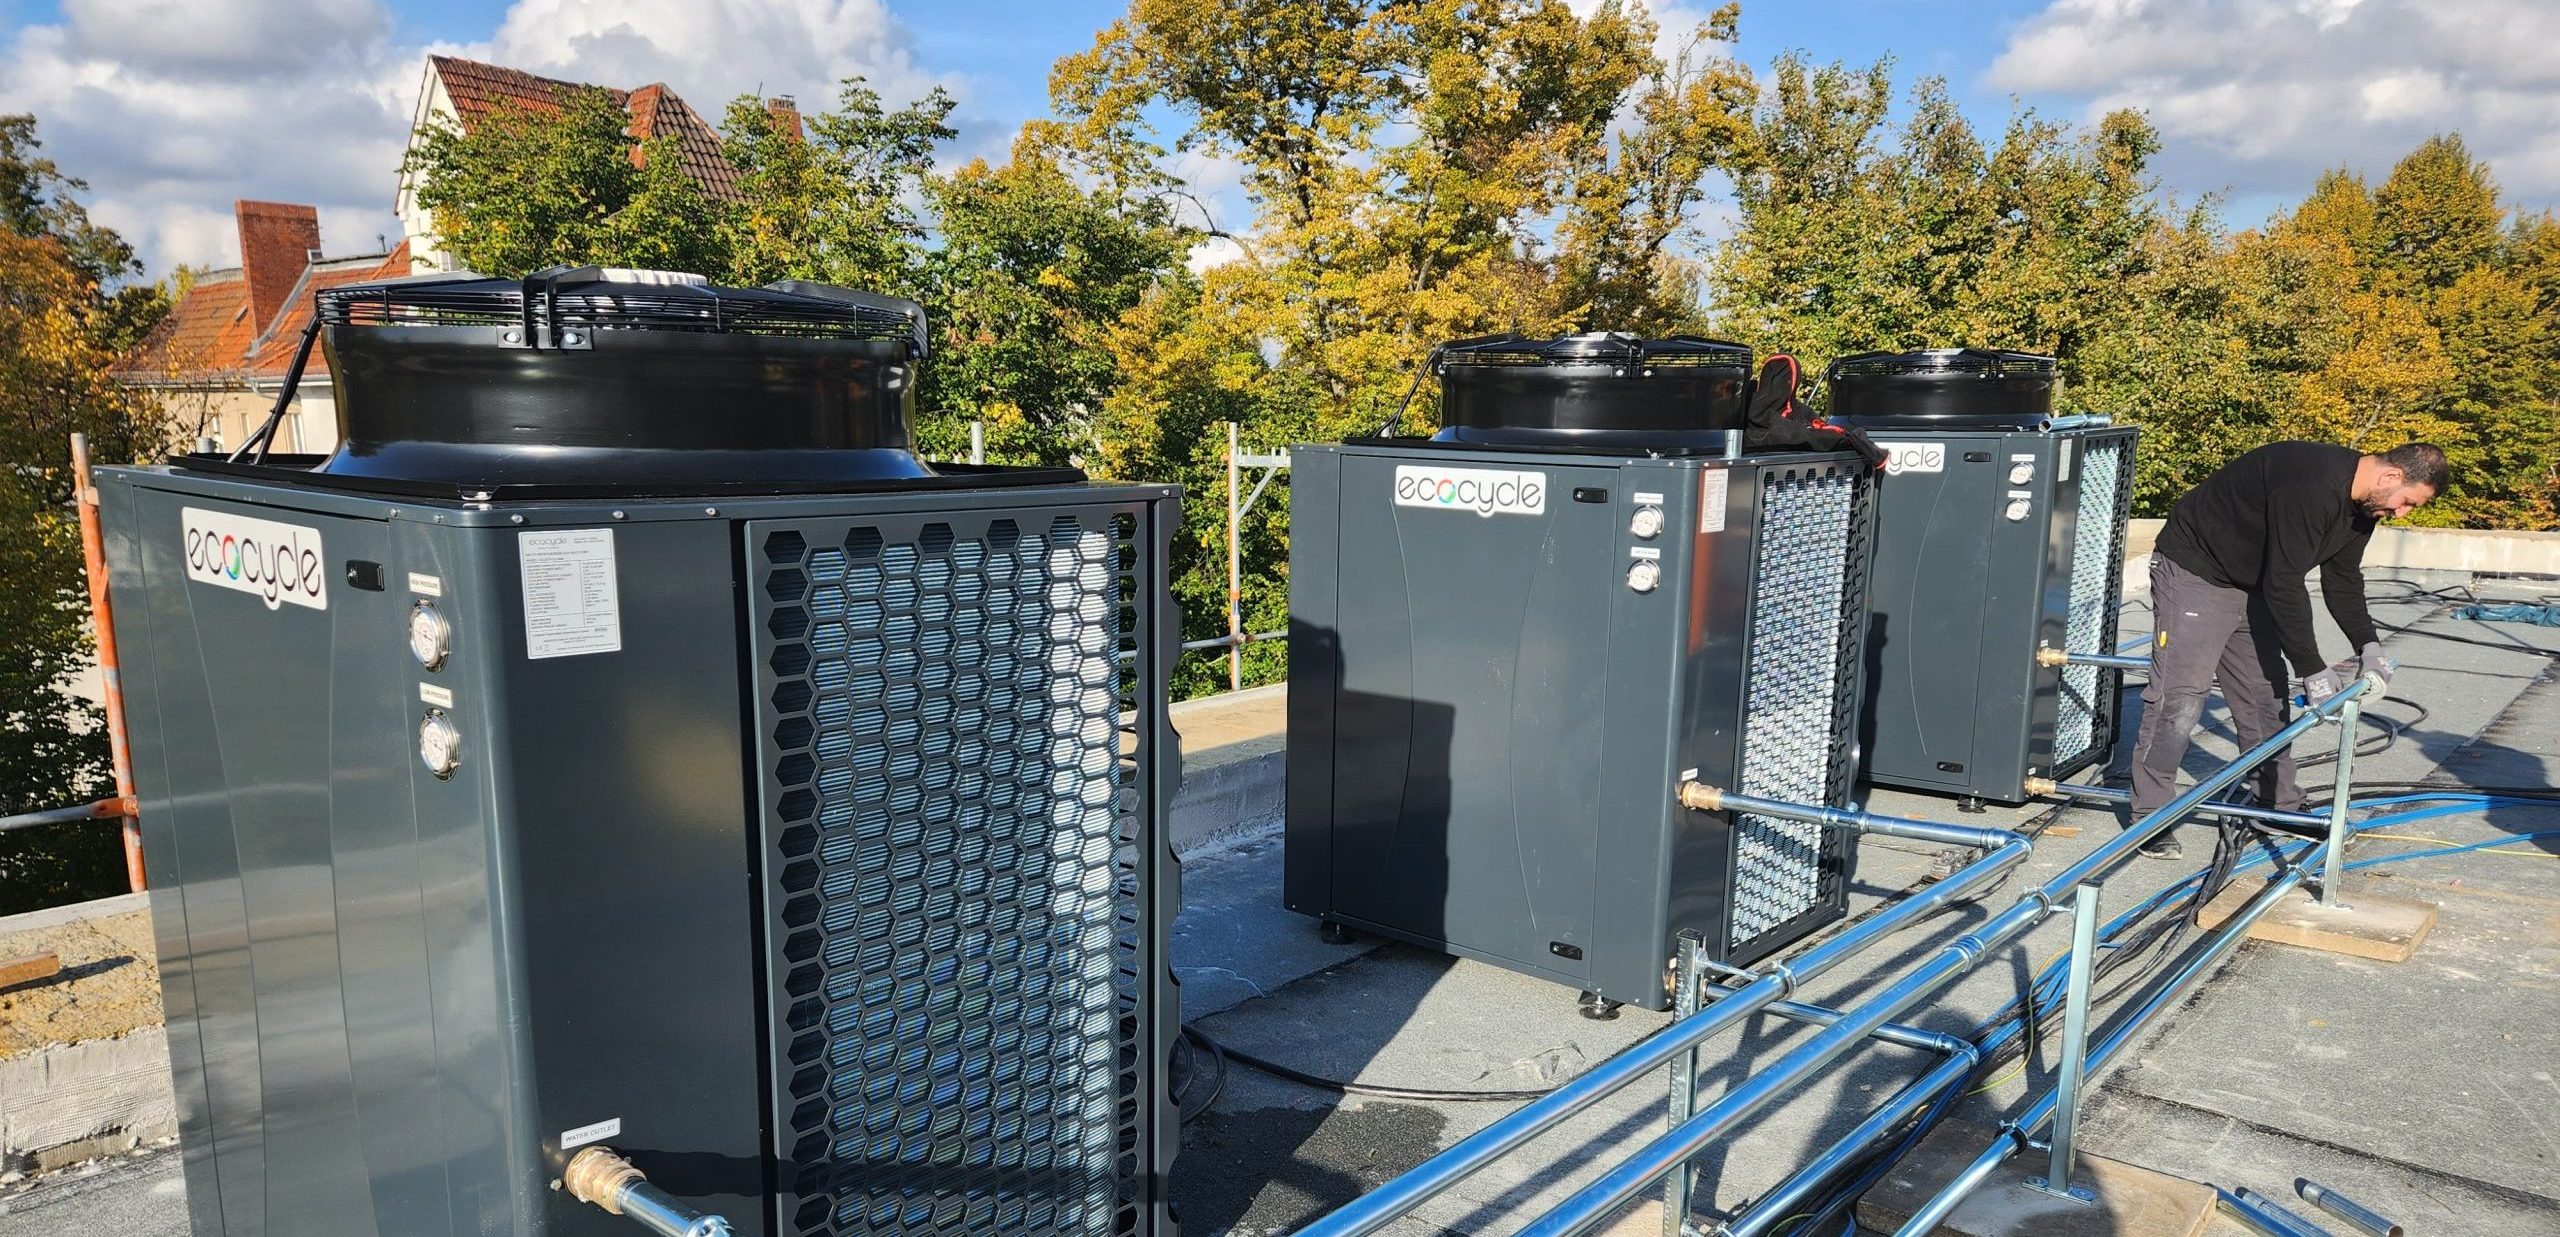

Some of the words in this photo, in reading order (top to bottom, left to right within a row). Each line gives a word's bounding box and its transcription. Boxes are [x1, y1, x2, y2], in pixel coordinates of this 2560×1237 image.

[1888, 445, 1940, 472] ycle
[1398, 475, 1541, 513] ecocycle
[188, 528, 321, 602] ecocycle
[566, 1131, 589, 1142] WATER
[591, 1124, 615, 1135] OUTLET
